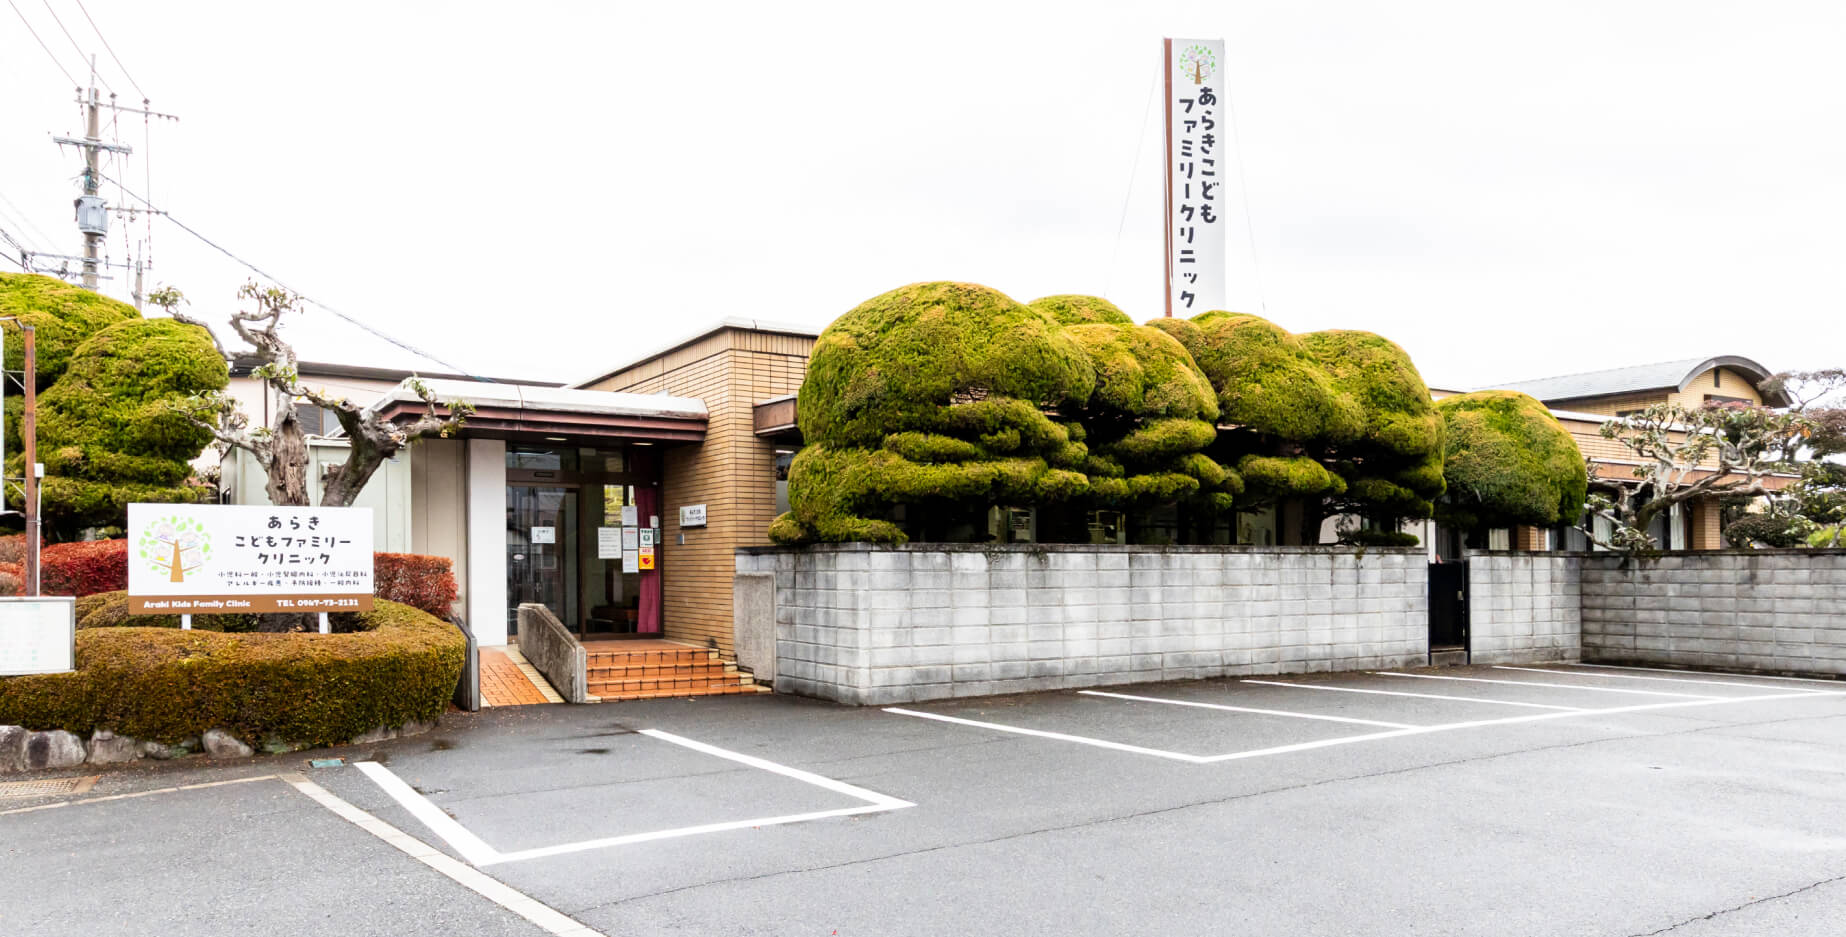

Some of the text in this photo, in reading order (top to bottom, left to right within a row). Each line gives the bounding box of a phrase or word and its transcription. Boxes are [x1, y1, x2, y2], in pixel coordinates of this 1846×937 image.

[1199, 87, 1219, 223] あらきこども
[1179, 98, 1197, 308] ファミリークリニック
[268, 515, 320, 531] あらき
[235, 535, 351, 548] こどもファミリー
[257, 552, 330, 565] クリニック
[143, 599, 169, 609] Araki
[172, 600, 192, 608] Kids
[194, 599, 225, 609] Family
[226, 599, 251, 607] Clinic
[276, 599, 295, 607] TEL
